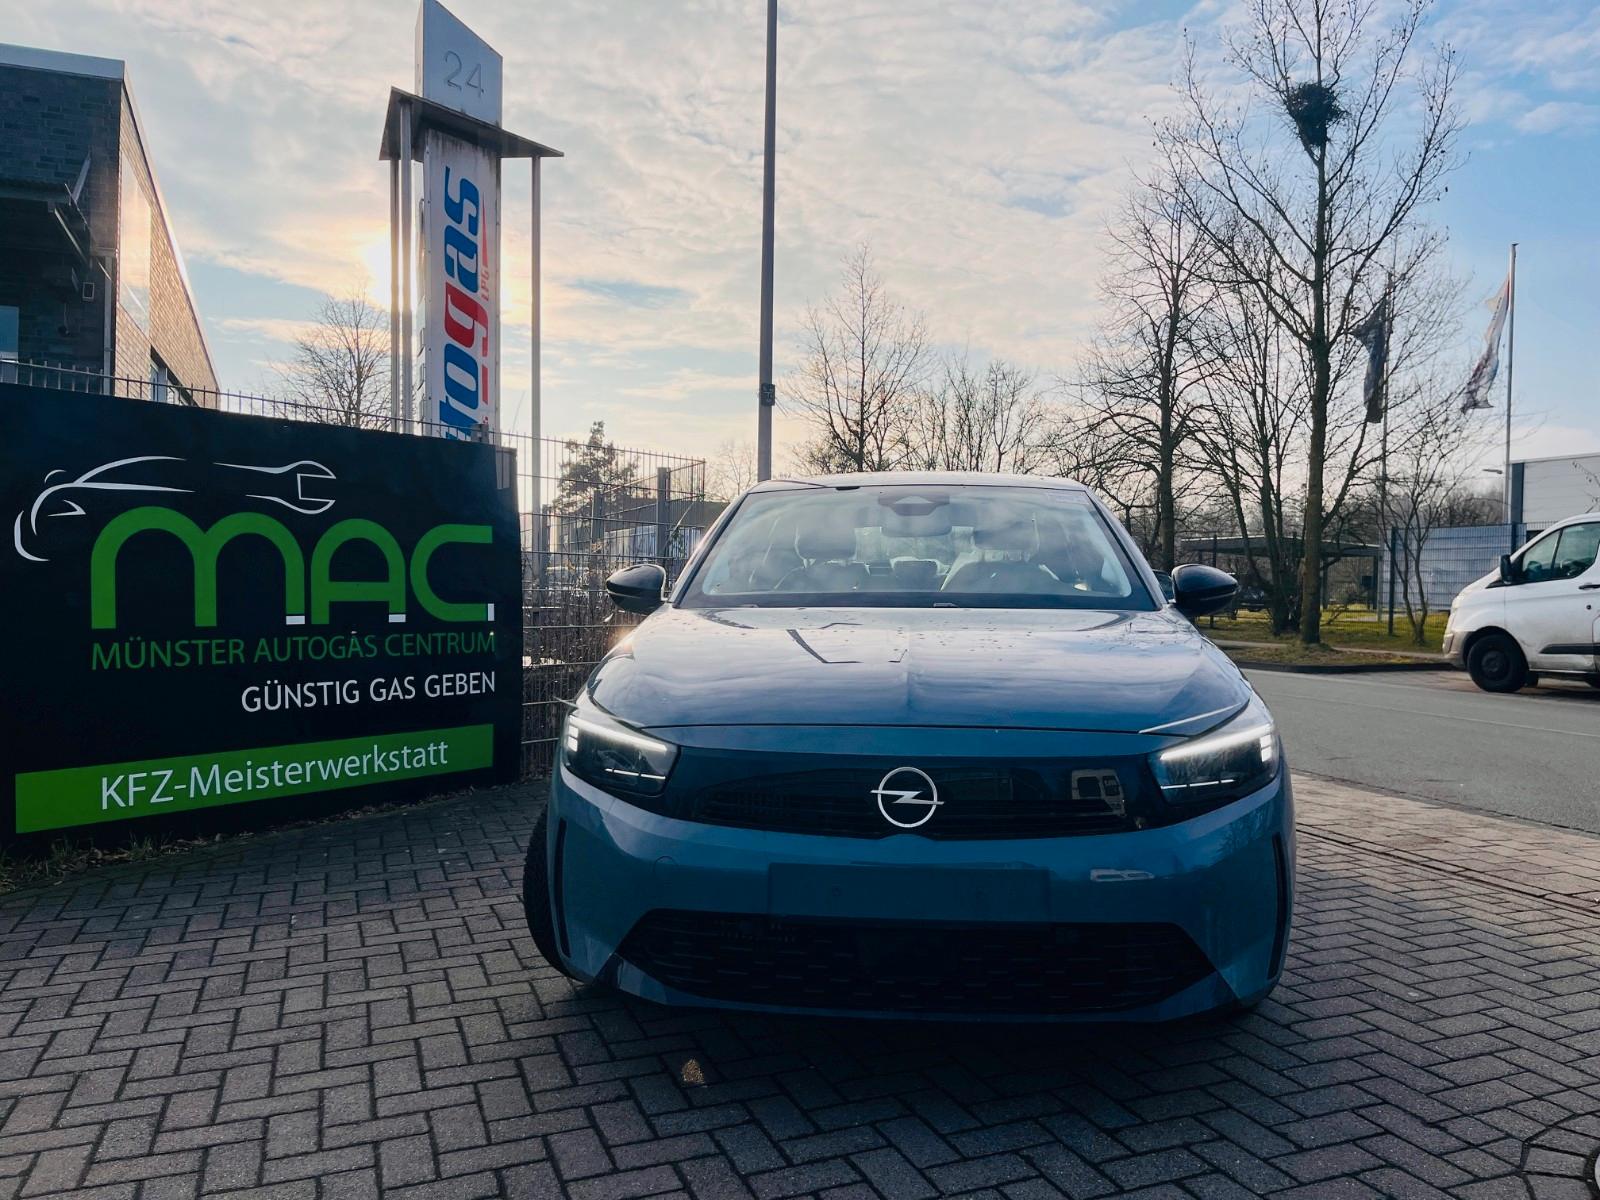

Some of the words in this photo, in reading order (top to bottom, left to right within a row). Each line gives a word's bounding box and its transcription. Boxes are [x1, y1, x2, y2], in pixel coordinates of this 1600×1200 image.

[444, 50, 484, 98] 24
[439, 165, 489, 441] togas
[91, 636, 245, 671] MÜNSTER
[253, 634, 378, 663] AUTOGAS
[385, 631, 496, 658] CENTRUM
[241, 679, 360, 713] GÜNSTIG
[370, 676, 416, 701] GAS
[424, 671, 496, 699] GEBEN
[101, 741, 448, 810] KFZ-Meisterwerkstatt
